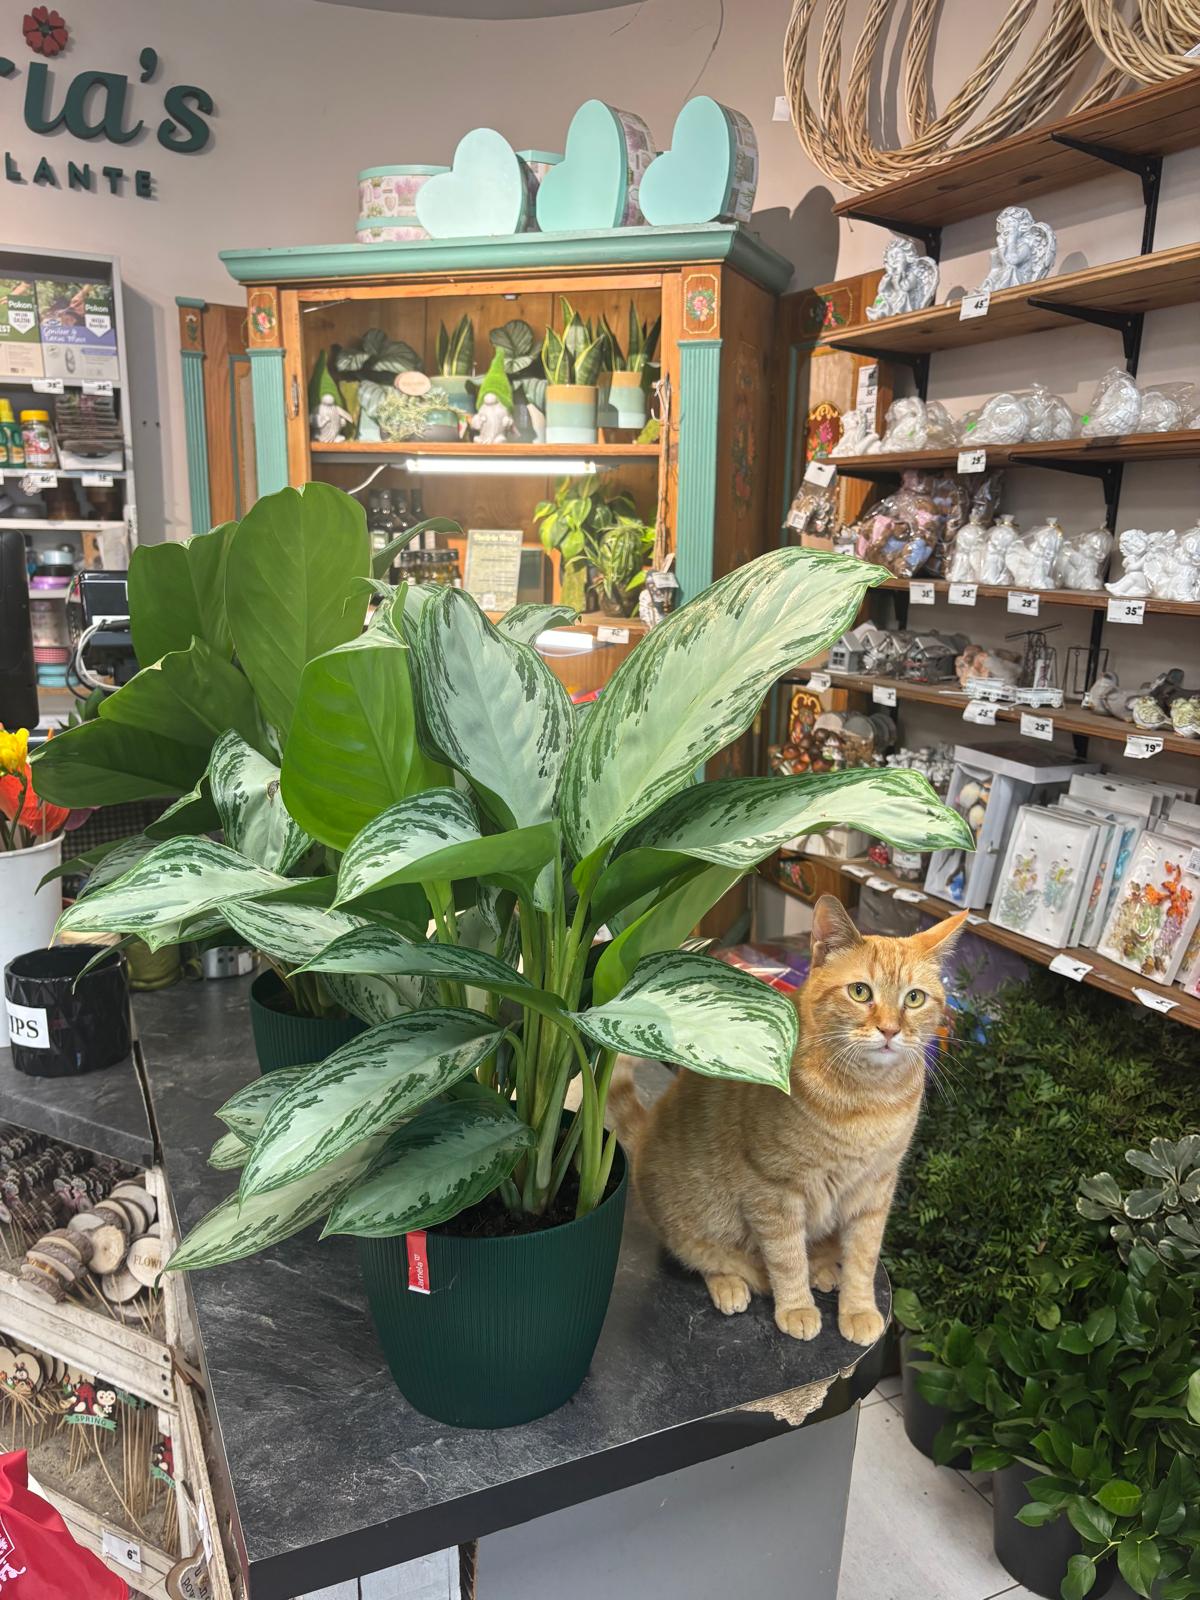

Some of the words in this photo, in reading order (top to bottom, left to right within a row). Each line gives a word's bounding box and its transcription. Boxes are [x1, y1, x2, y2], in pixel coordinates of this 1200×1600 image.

[0, 47, 213, 153] ia's
[5, 151, 152, 198] LANTE
[8, 300, 33, 309] Pokon
[85, 303, 109, 313] Pokon
[1125, 606, 1137, 616] 35
[1144, 743, 1156, 753] 19
[75, 1414, 107, 1426] SPRING
